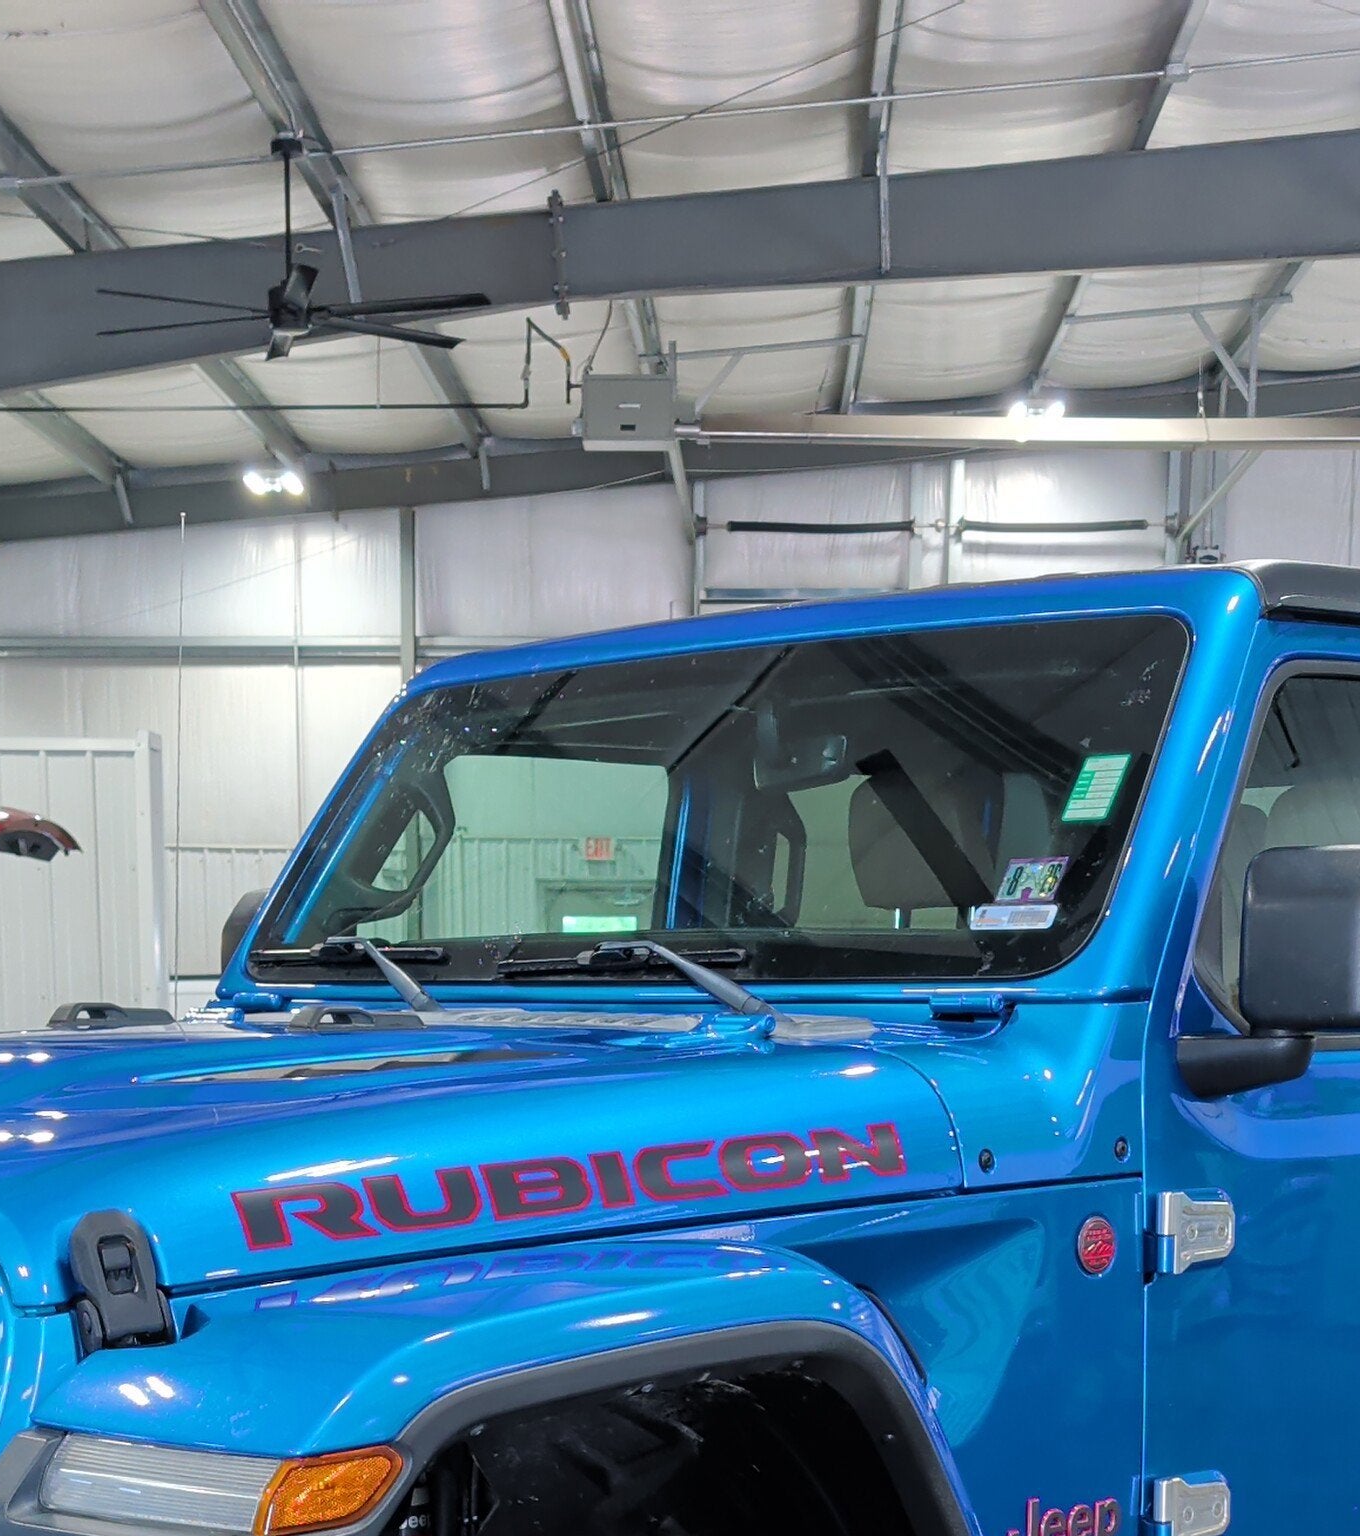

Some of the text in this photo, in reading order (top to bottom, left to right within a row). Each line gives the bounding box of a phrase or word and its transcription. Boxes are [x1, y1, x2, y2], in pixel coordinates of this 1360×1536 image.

[585, 837, 612, 860] EXIT
[1006, 866, 1025, 896] 8
[231, 1122, 906, 1251] RUBICON
